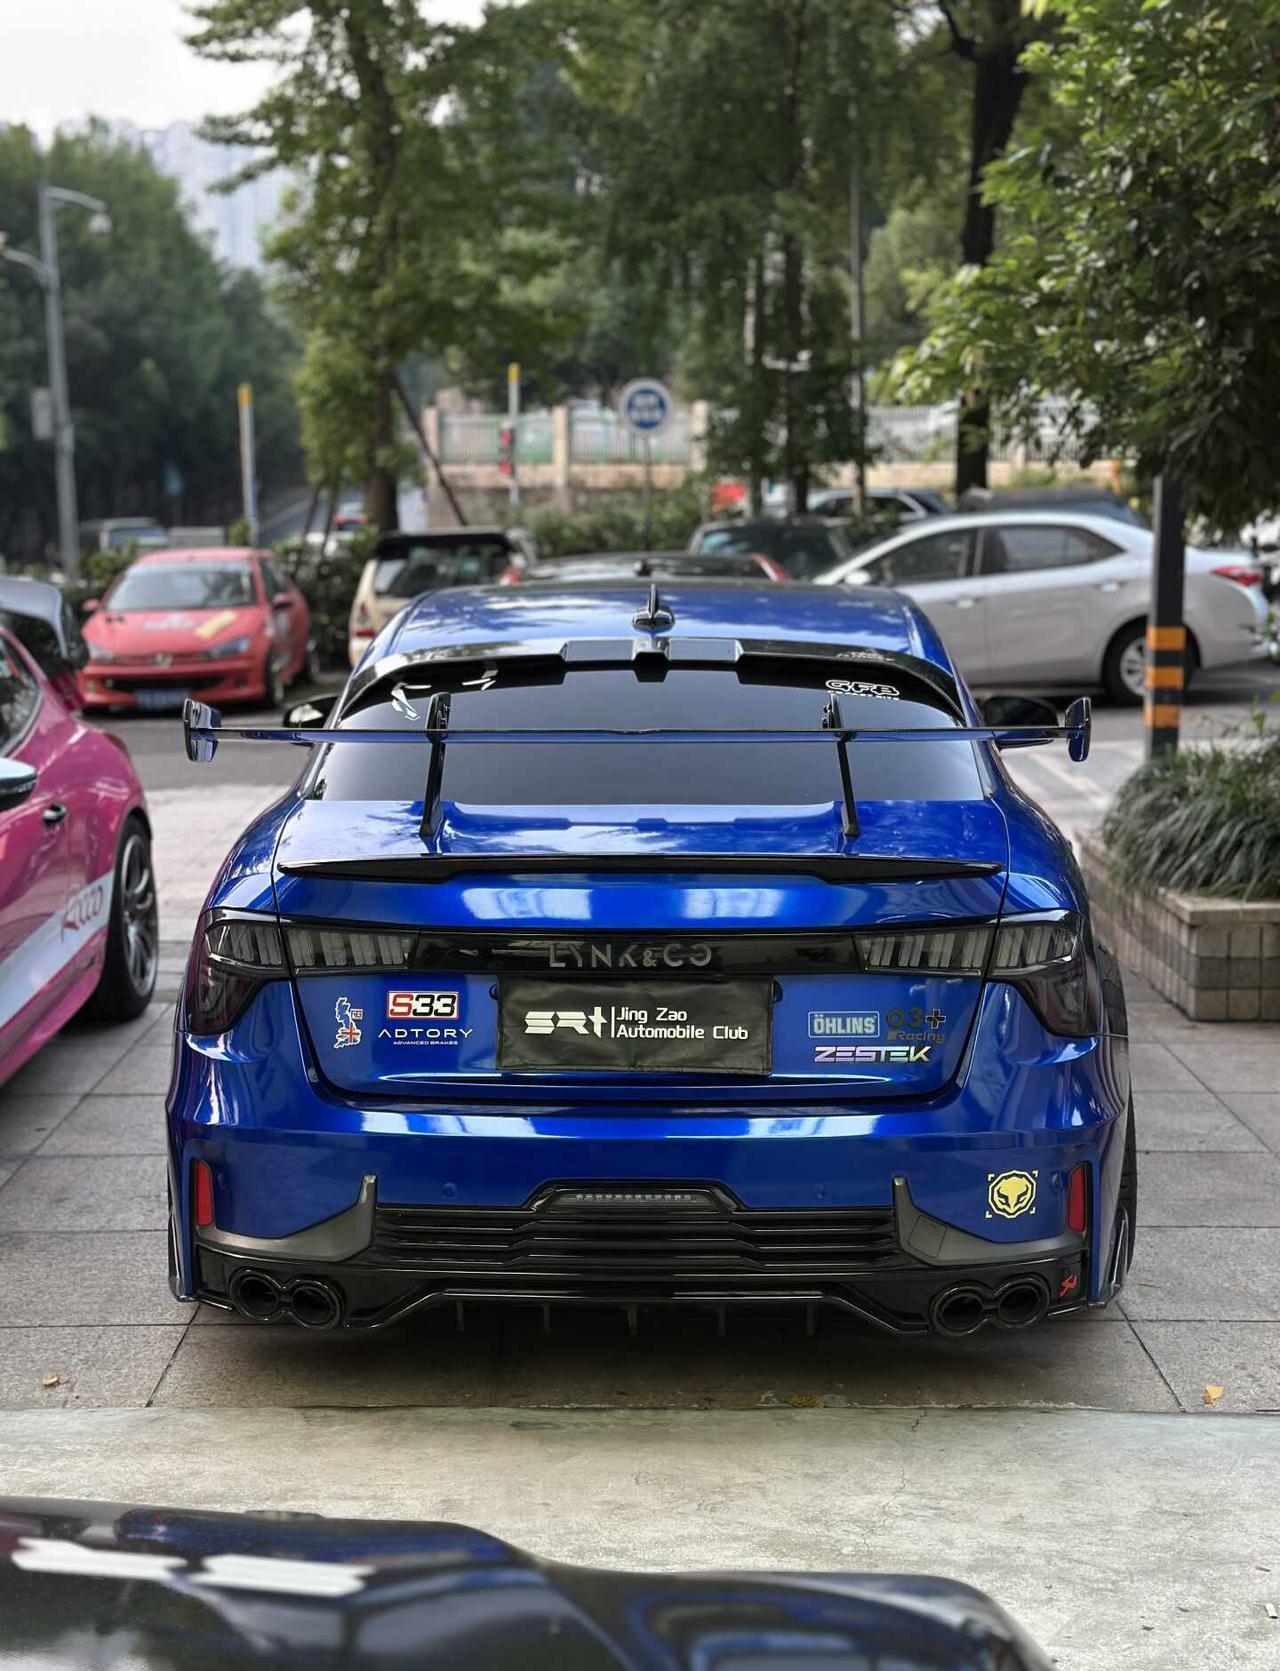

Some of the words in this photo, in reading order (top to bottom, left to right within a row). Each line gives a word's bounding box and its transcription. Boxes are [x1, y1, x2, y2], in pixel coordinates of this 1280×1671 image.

[389, 993, 457, 1017] S33
[616, 1006, 648, 1023] Jing
[656, 1007, 688, 1022] Zao
[616, 1024, 705, 1039] Automobile
[713, 1025, 749, 1040] Club
[813, 1014, 876, 1035] ÖHLINS
[378, 1028, 474, 1039] ADTORY
[894, 1030, 945, 1044] Racing
[814, 1046, 932, 1063] ZESTEK
